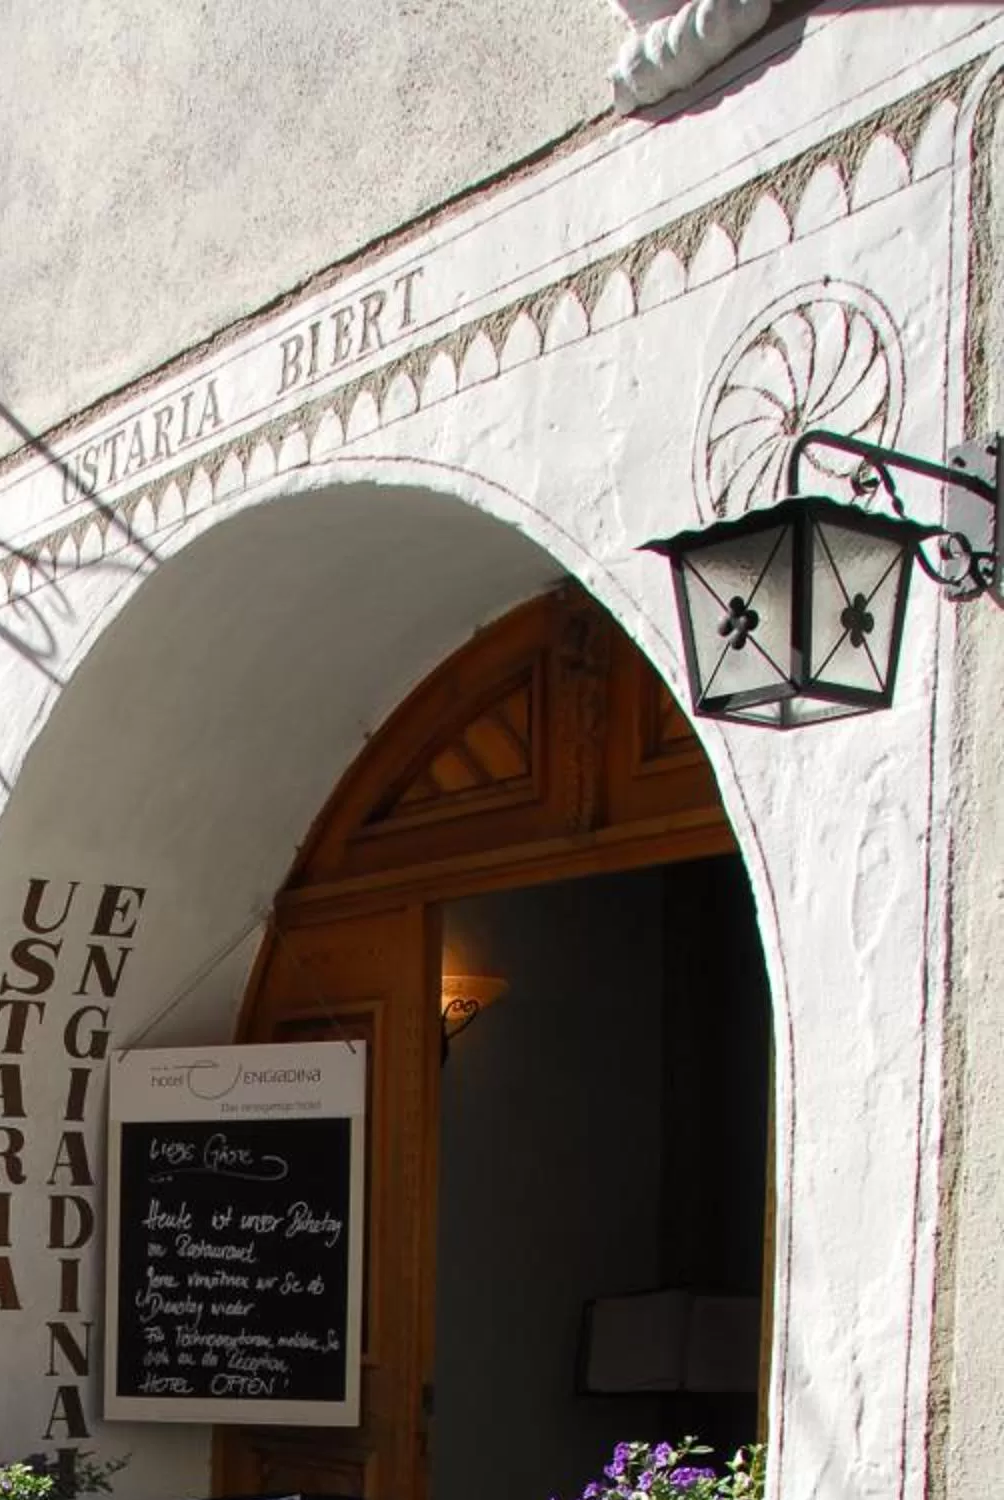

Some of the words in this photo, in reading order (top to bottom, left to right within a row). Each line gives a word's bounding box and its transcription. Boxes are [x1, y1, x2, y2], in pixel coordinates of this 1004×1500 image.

[60, 377, 225, 506] USTARIA
[277, 266, 425, 396] BIERT
[142, 1199, 193, 1231] Heute
[211, 1205, 233, 1231] ist
